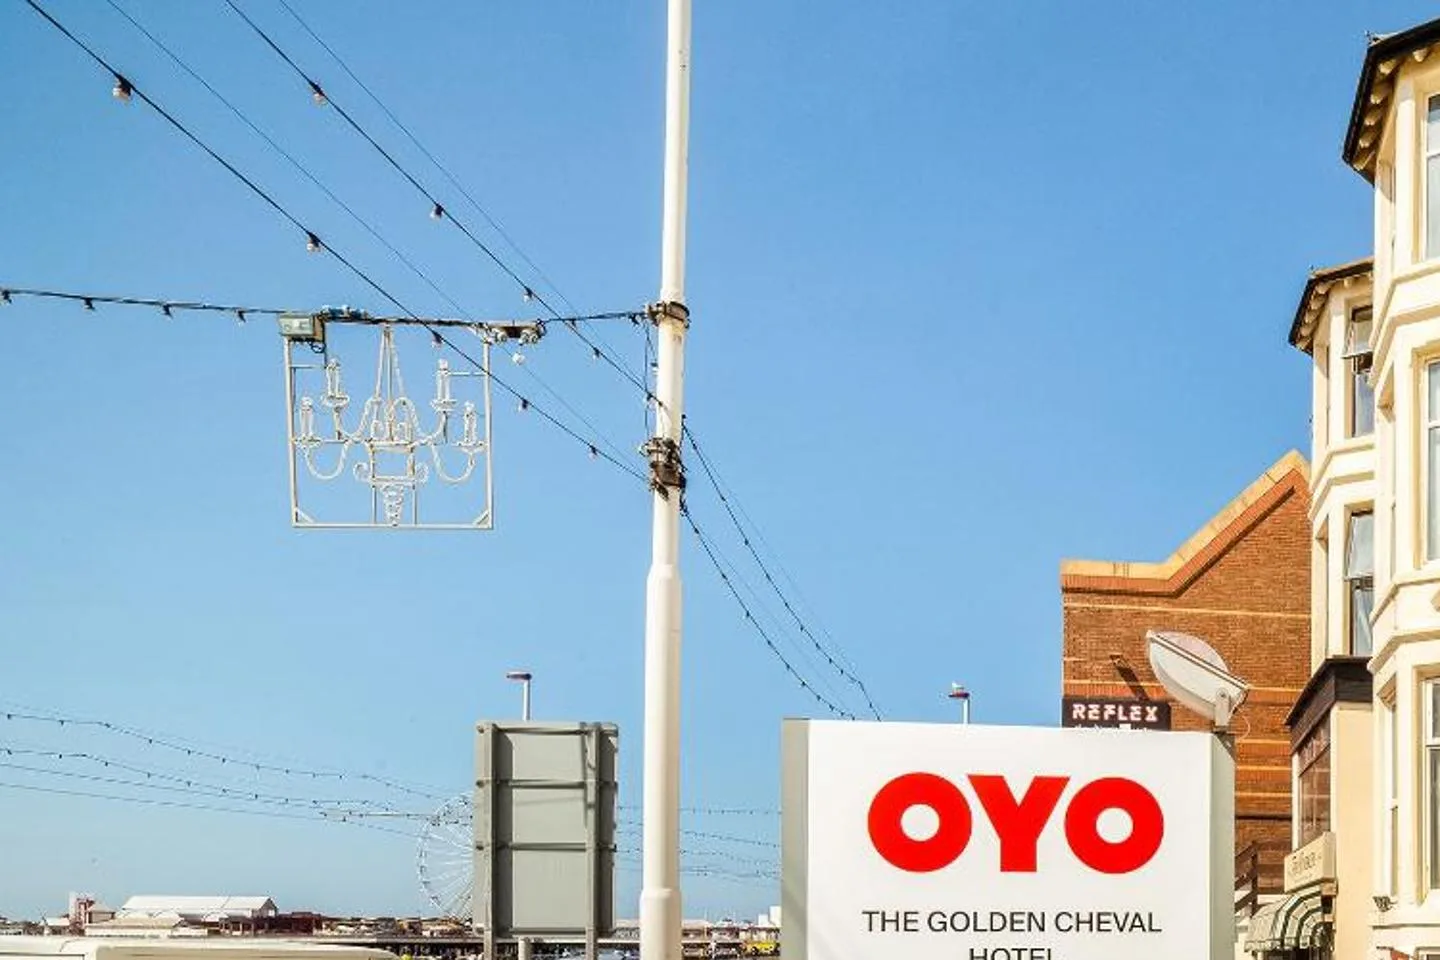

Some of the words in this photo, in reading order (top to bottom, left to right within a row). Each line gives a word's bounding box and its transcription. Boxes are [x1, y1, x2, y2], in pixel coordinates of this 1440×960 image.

[1071, 702, 1159, 722] REFLEX
[867, 772, 1164, 874] OYO
[861, 910, 919, 932] THE
[927, 911, 1046, 933] GOLDEN
[1054, 911, 1163, 933] CHEVAL
